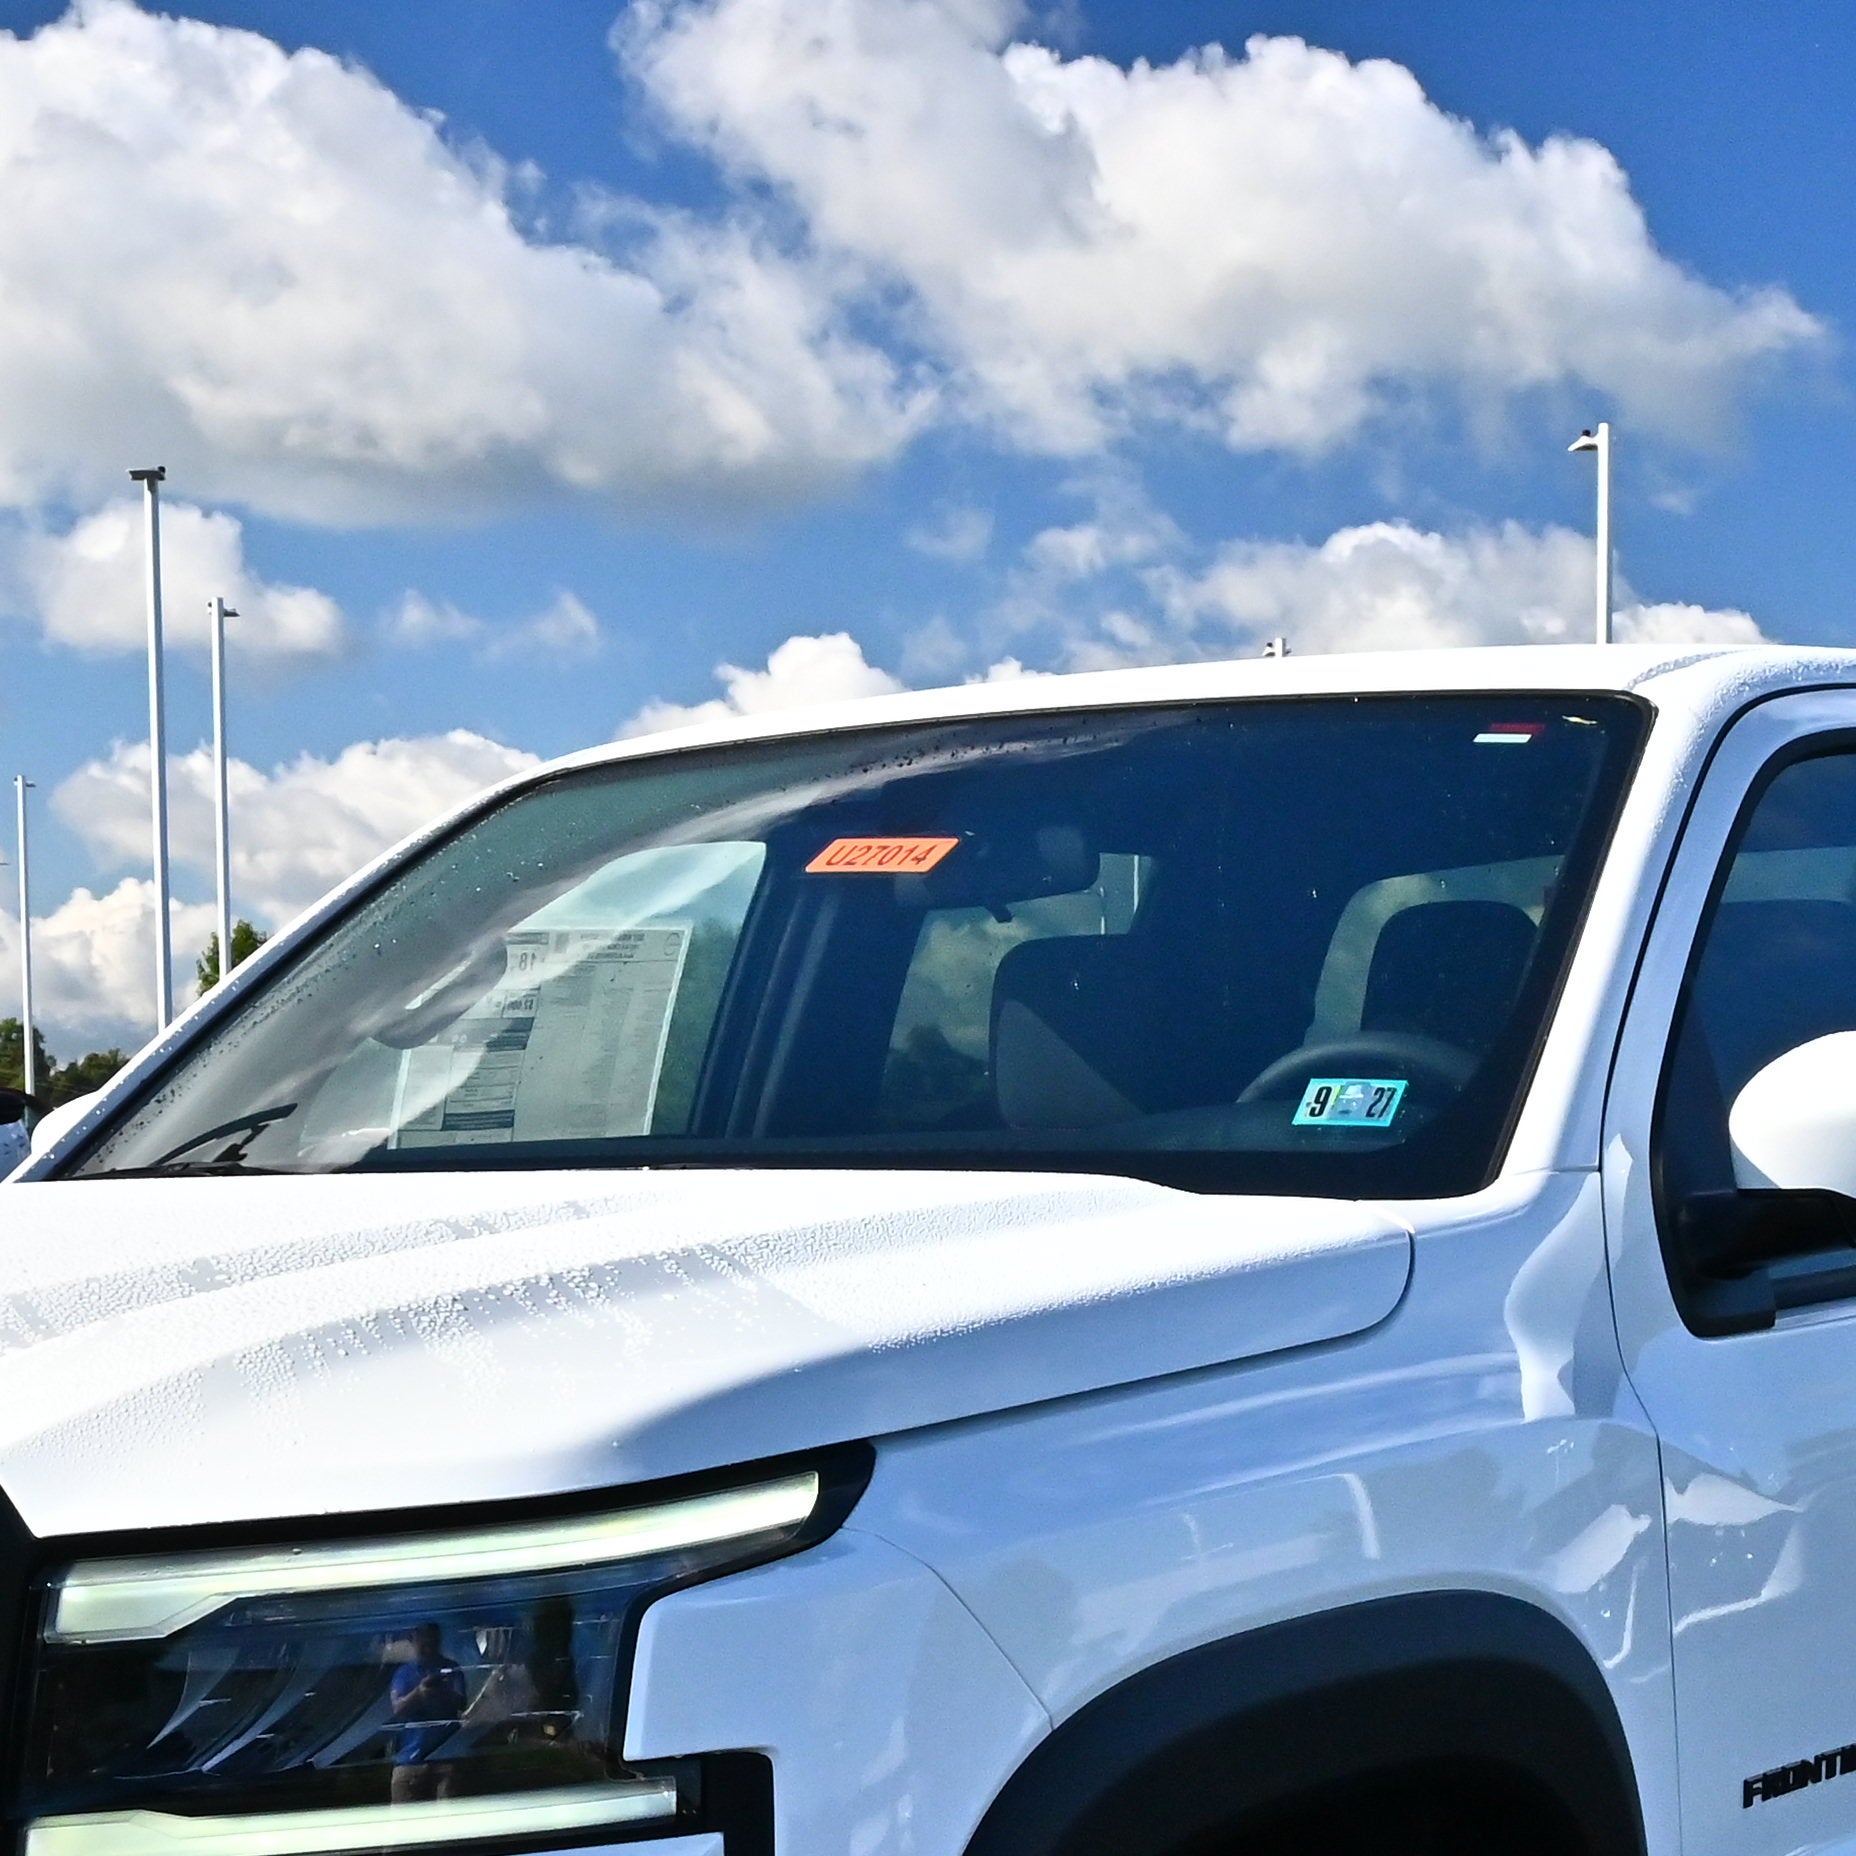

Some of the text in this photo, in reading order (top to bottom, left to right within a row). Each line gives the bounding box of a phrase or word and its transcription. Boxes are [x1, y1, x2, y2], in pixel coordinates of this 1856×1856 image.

[825, 844, 938, 866] U27014
[1308, 1085, 1397, 1118] 9 27
